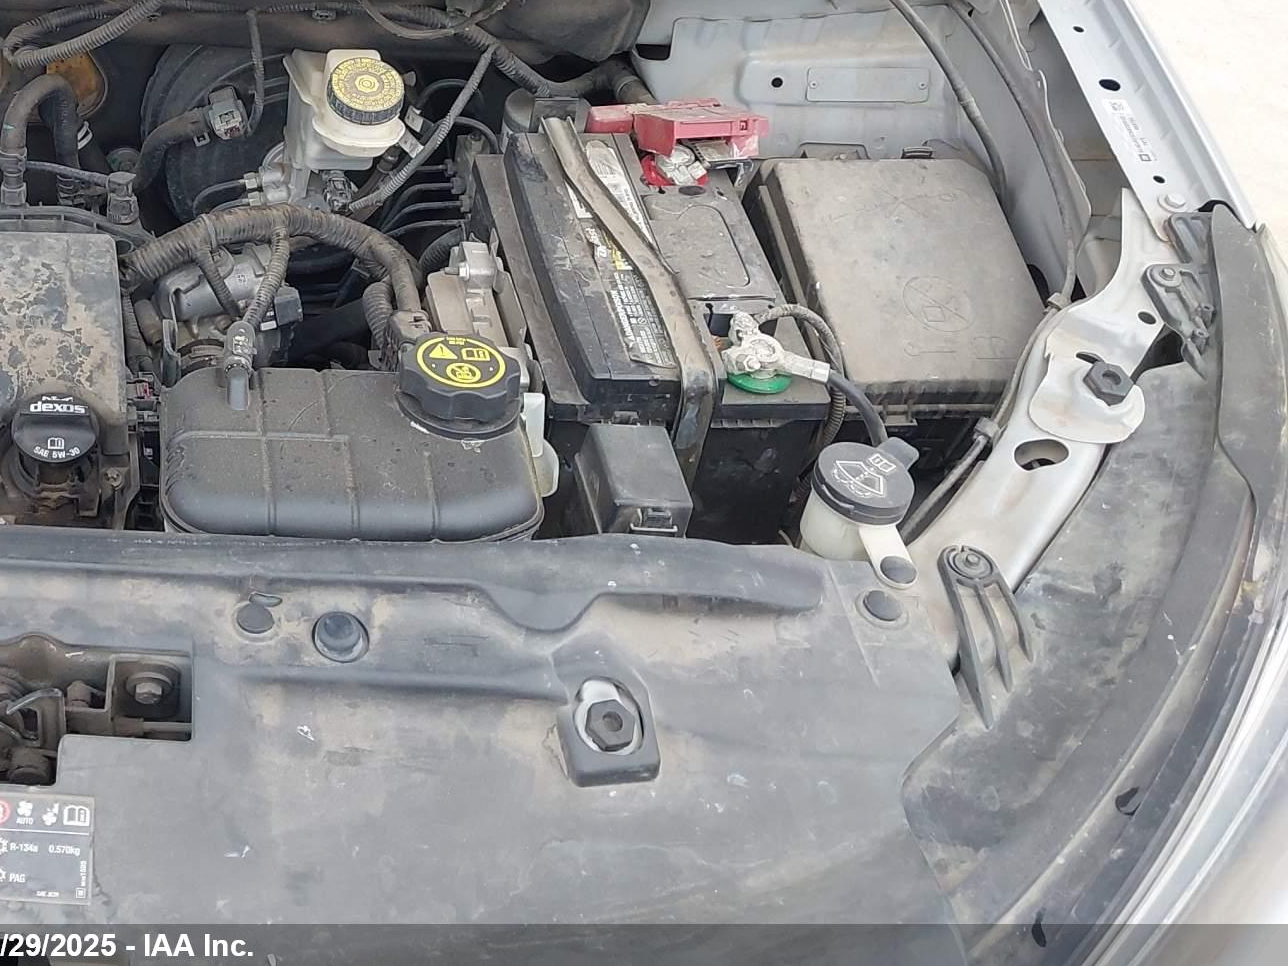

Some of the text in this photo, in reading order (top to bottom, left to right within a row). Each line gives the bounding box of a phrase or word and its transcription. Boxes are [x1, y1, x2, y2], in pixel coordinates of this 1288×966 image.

[30, 401, 89, 414] dexos
[33, 446, 81, 459] SAE 5W-30
[16, 817, 34, 825] AUTO
[10, 842, 81, 856] R-134a 0.570kg
[9, 873, 26, 883] PAG
